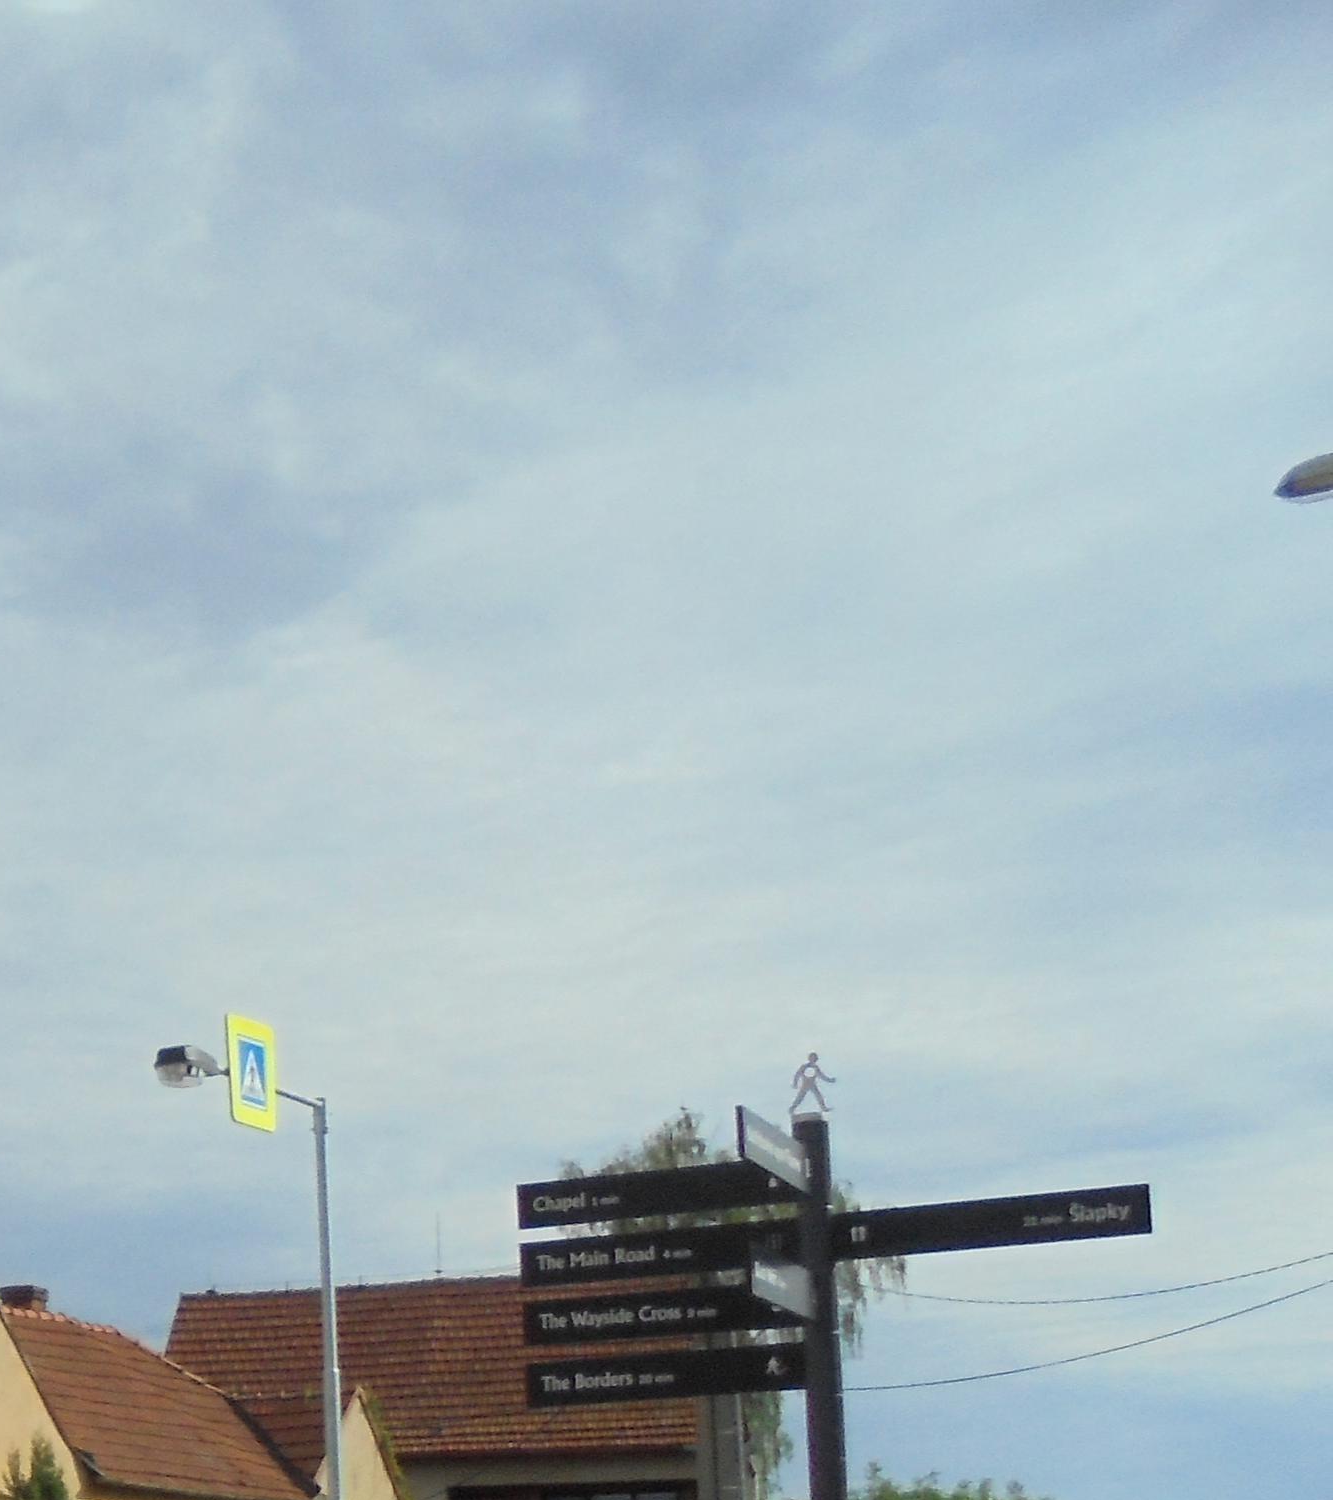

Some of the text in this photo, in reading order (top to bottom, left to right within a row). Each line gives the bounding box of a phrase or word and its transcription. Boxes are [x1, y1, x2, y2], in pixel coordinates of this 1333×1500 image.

[533, 1192, 587, 1213] Chapel
[536, 1253, 566, 1271] The
[569, 1250, 610, 1268] Main
[614, 1245, 656, 1265] Road
[539, 1312, 569, 1329] The
[570, 1307, 633, 1330] Wayside
[638, 1305, 683, 1322] Cross
[541, 1375, 571, 1392] The
[574, 1371, 633, 1390] Borders
